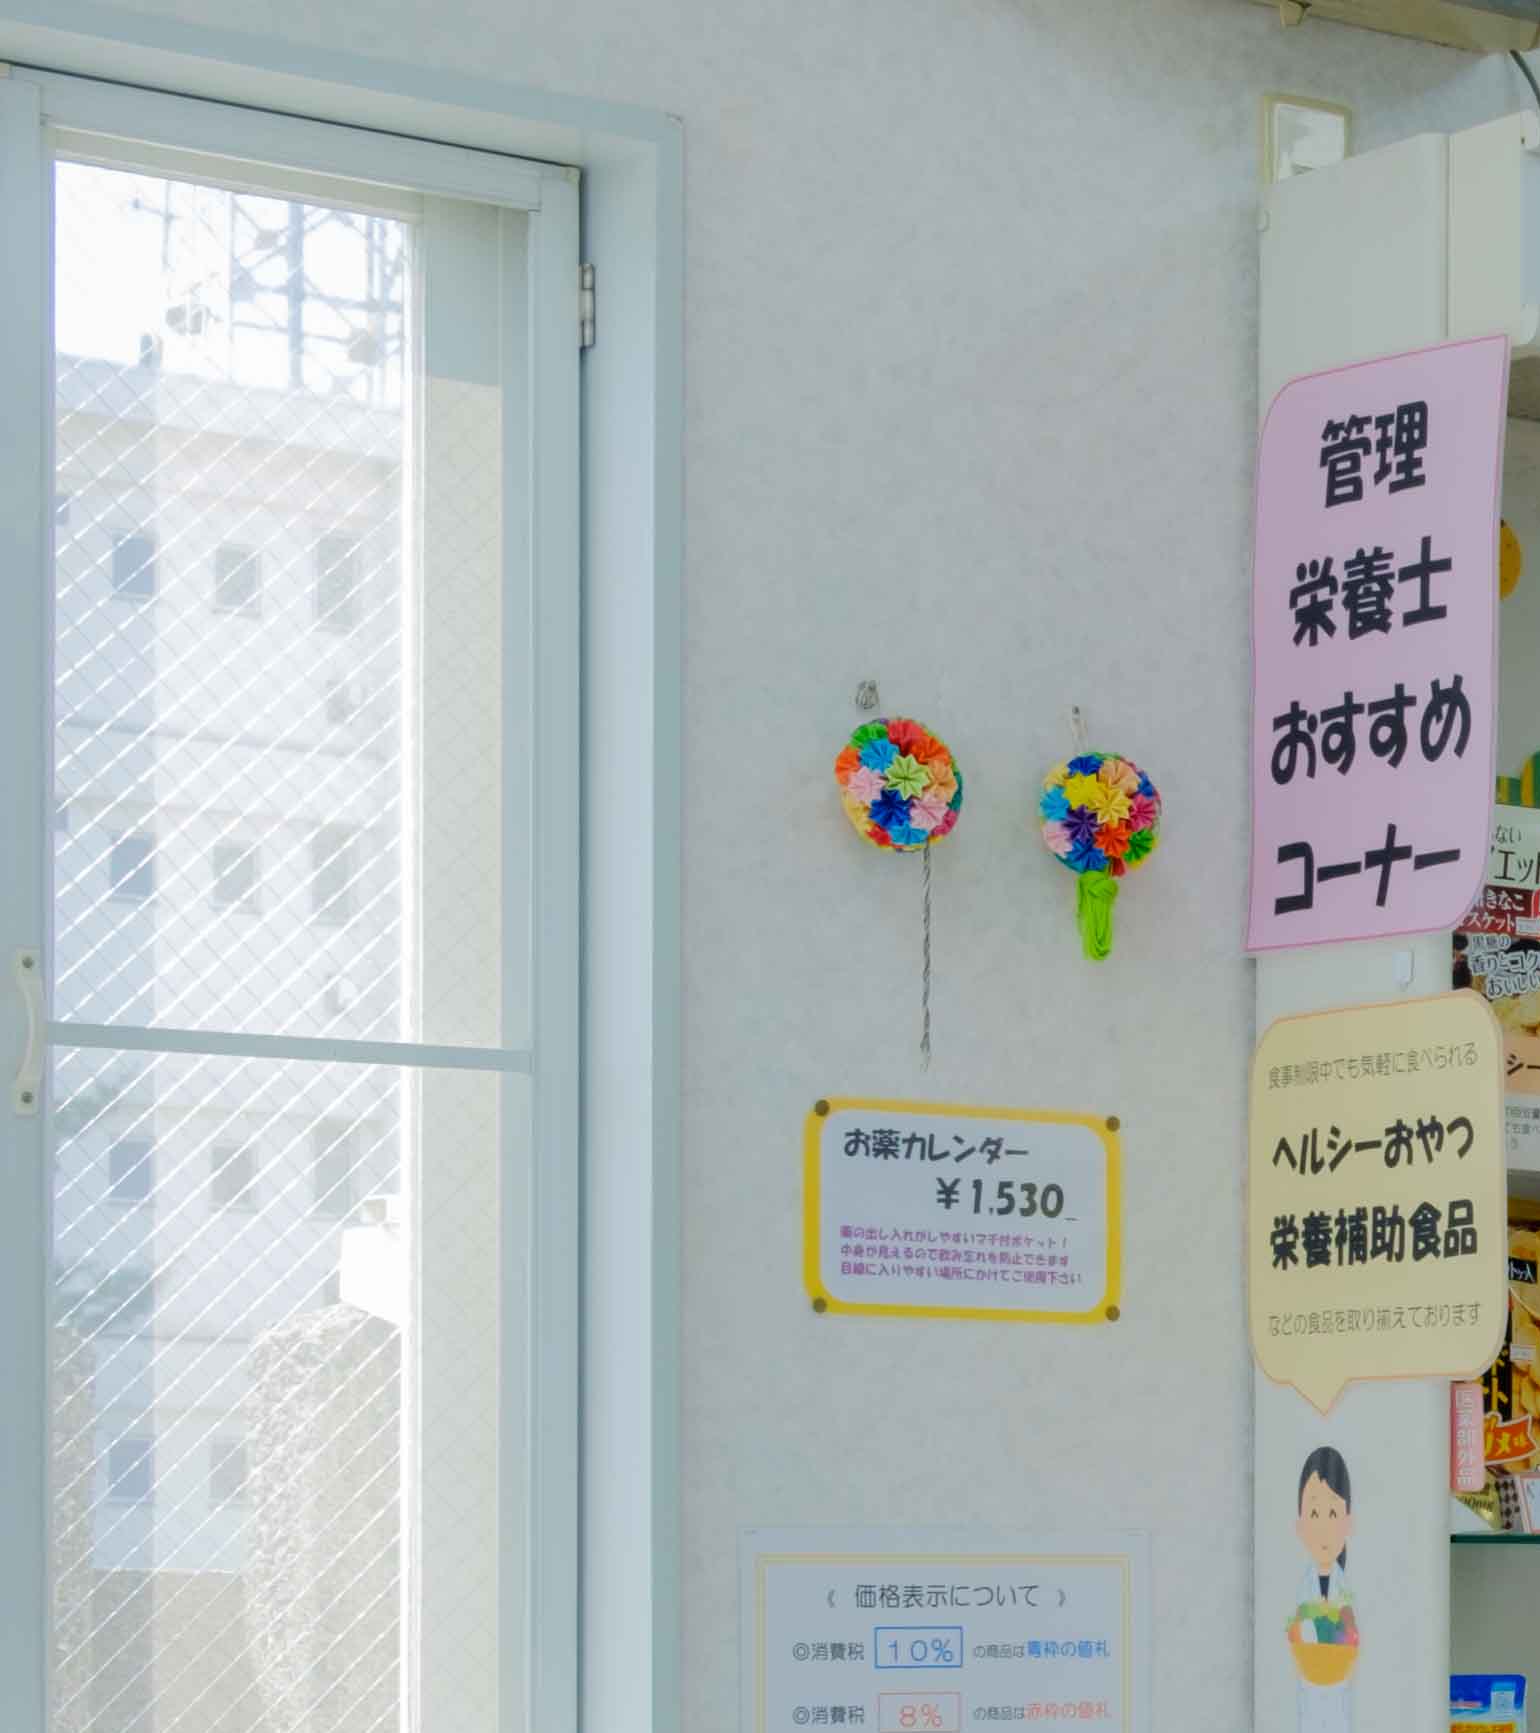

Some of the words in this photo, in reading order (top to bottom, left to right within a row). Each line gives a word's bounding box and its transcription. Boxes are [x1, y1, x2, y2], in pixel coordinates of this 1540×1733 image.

[1319, 400, 1428, 508] 管理
[1289, 536, 1452, 646] 栄養士
[1271, 674, 1471, 784] おすすめ
[1275, 824, 1460, 916] コーナー
[844, 1128, 1029, 1164] お薬カレンダー
[1272, 1115, 1474, 1174] ヘルシーおやつ
[1270, 1199, 1478, 1270] 栄養補助食品
[855, 1584, 1040, 1608] 価格表示について
[887, 1639, 954, 1663] 10%
[899, 1704, 943, 1728] 8%
